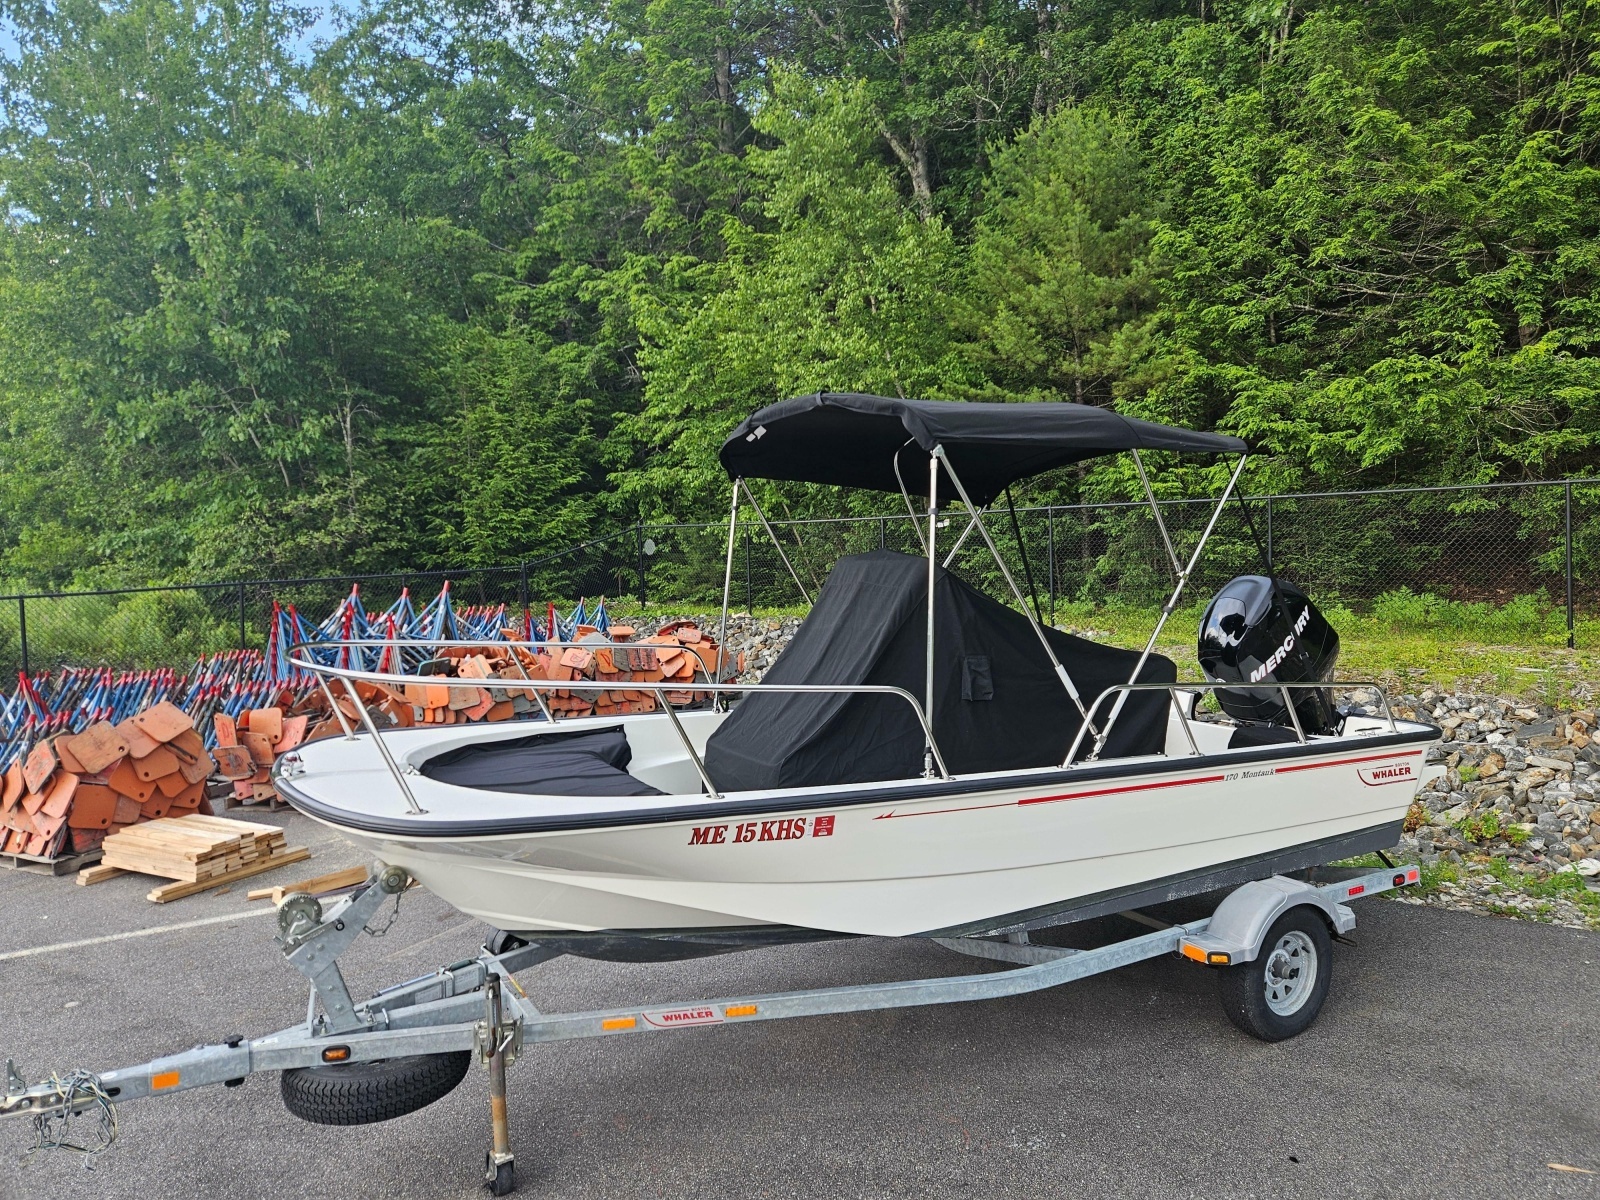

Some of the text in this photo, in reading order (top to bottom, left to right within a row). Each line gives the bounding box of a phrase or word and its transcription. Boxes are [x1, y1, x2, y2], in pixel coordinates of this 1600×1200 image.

[1225, 768, 1275, 781] 170 Montauk
[1372, 767, 1411, 780] WHALER
[687, 825, 729, 846] ME
[662, 1010, 714, 1022] WHALER
